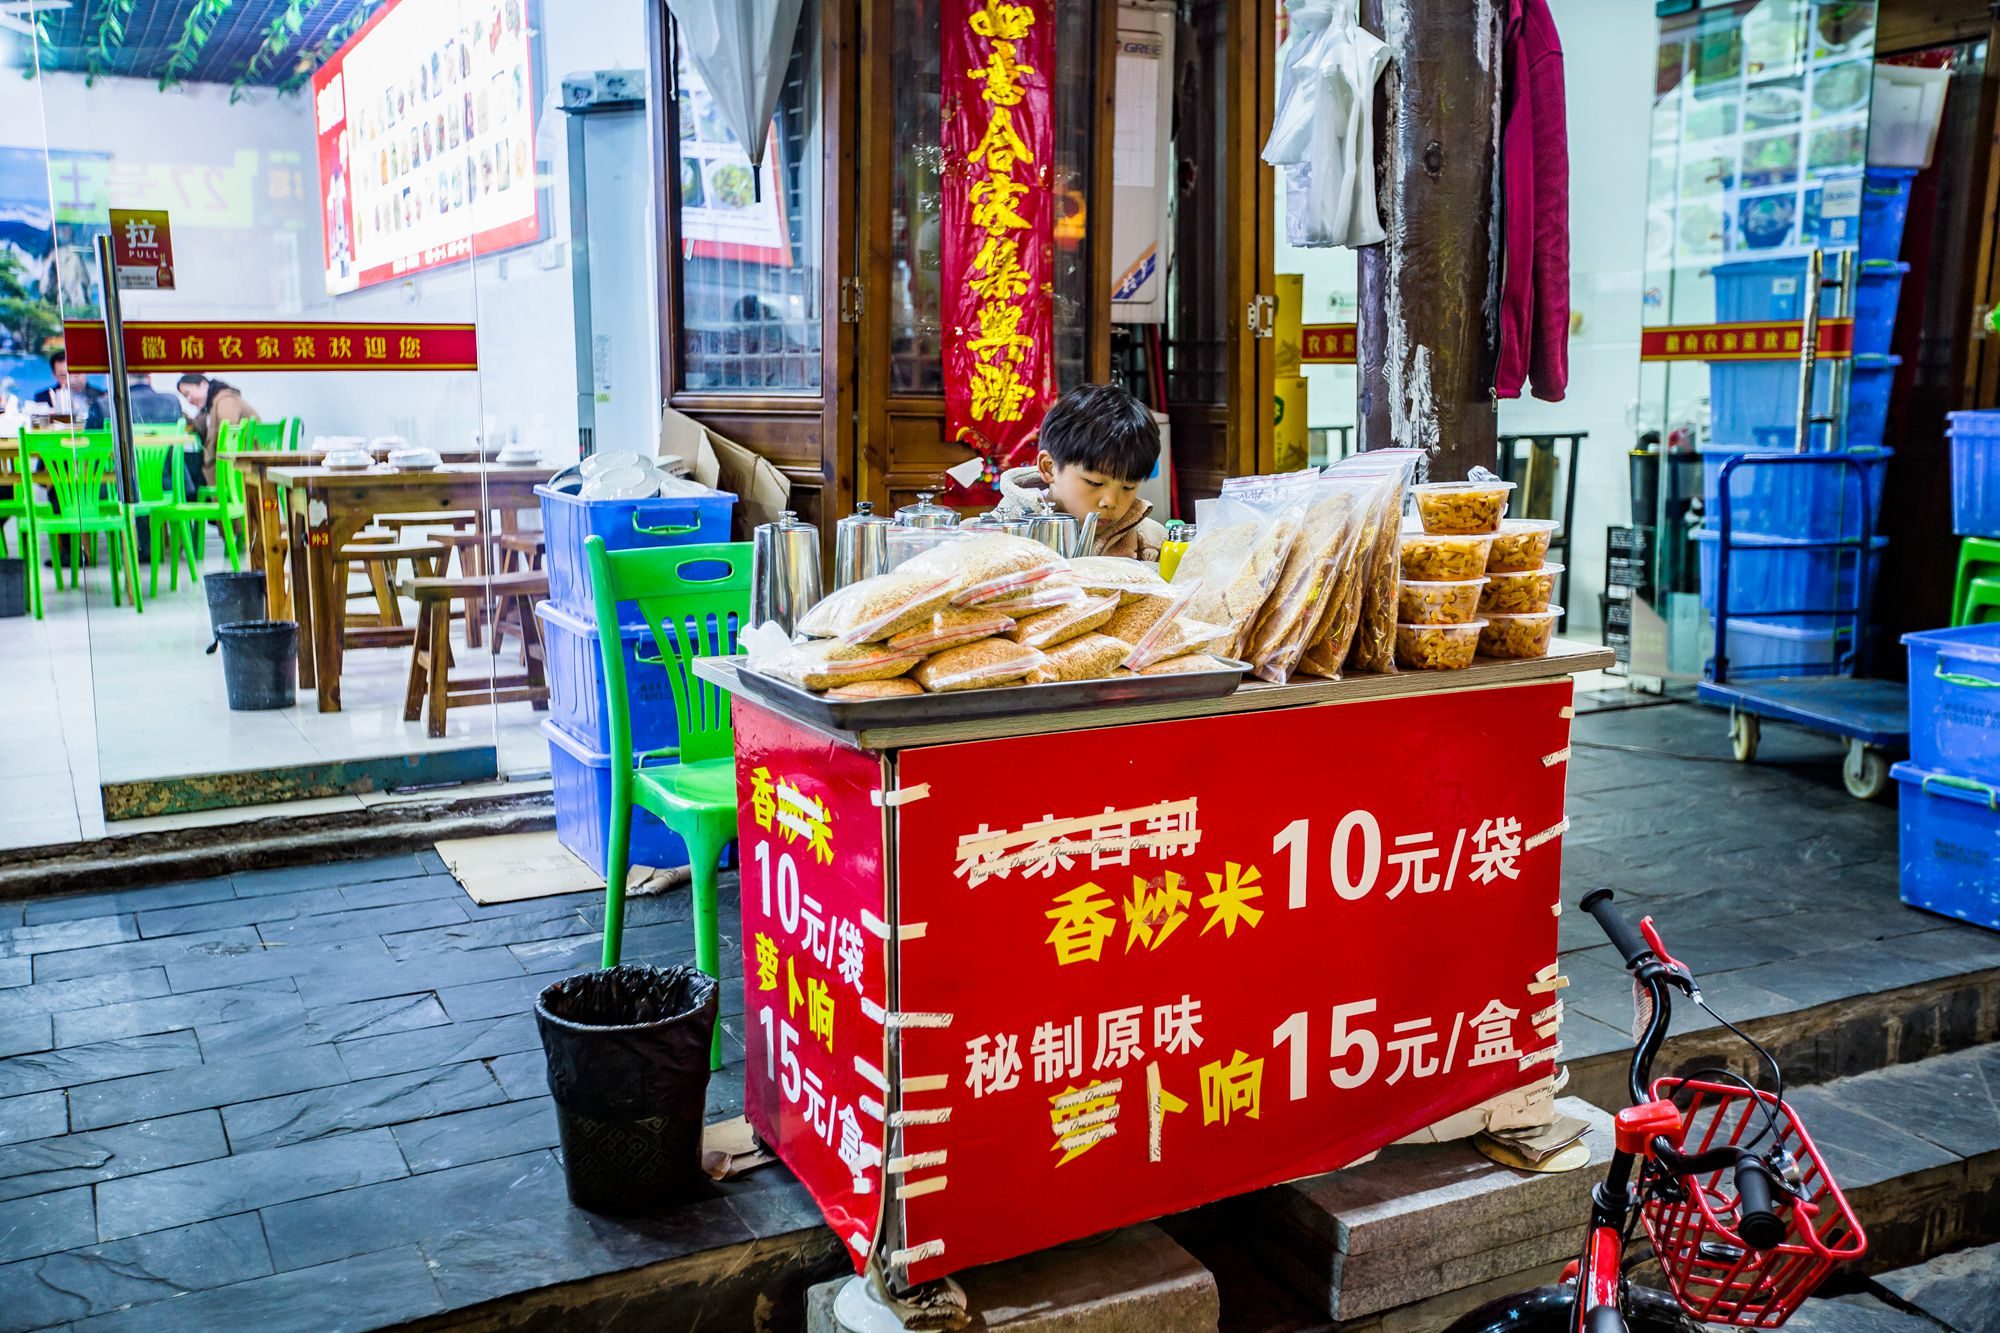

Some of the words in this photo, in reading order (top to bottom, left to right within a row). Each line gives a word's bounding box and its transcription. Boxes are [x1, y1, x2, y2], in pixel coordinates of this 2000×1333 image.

[1123, 42, 1162, 56] GREE
[125, 218, 158, 249] 拉
[128, 249, 159, 259] PULL
[141, 335, 421, 360] 徽府农家菜欢迎您
[1665, 330, 1821, 353] 徽府农家菜欢迎
[1272, 809, 1522, 911] 10元/袋
[1044, 861, 1265, 966] 香炒米
[754, 931, 835, 1055] 萝卜响
[964, 994, 1204, 1099] 秘制原味
[1272, 998, 1523, 1102] 15元/盒
